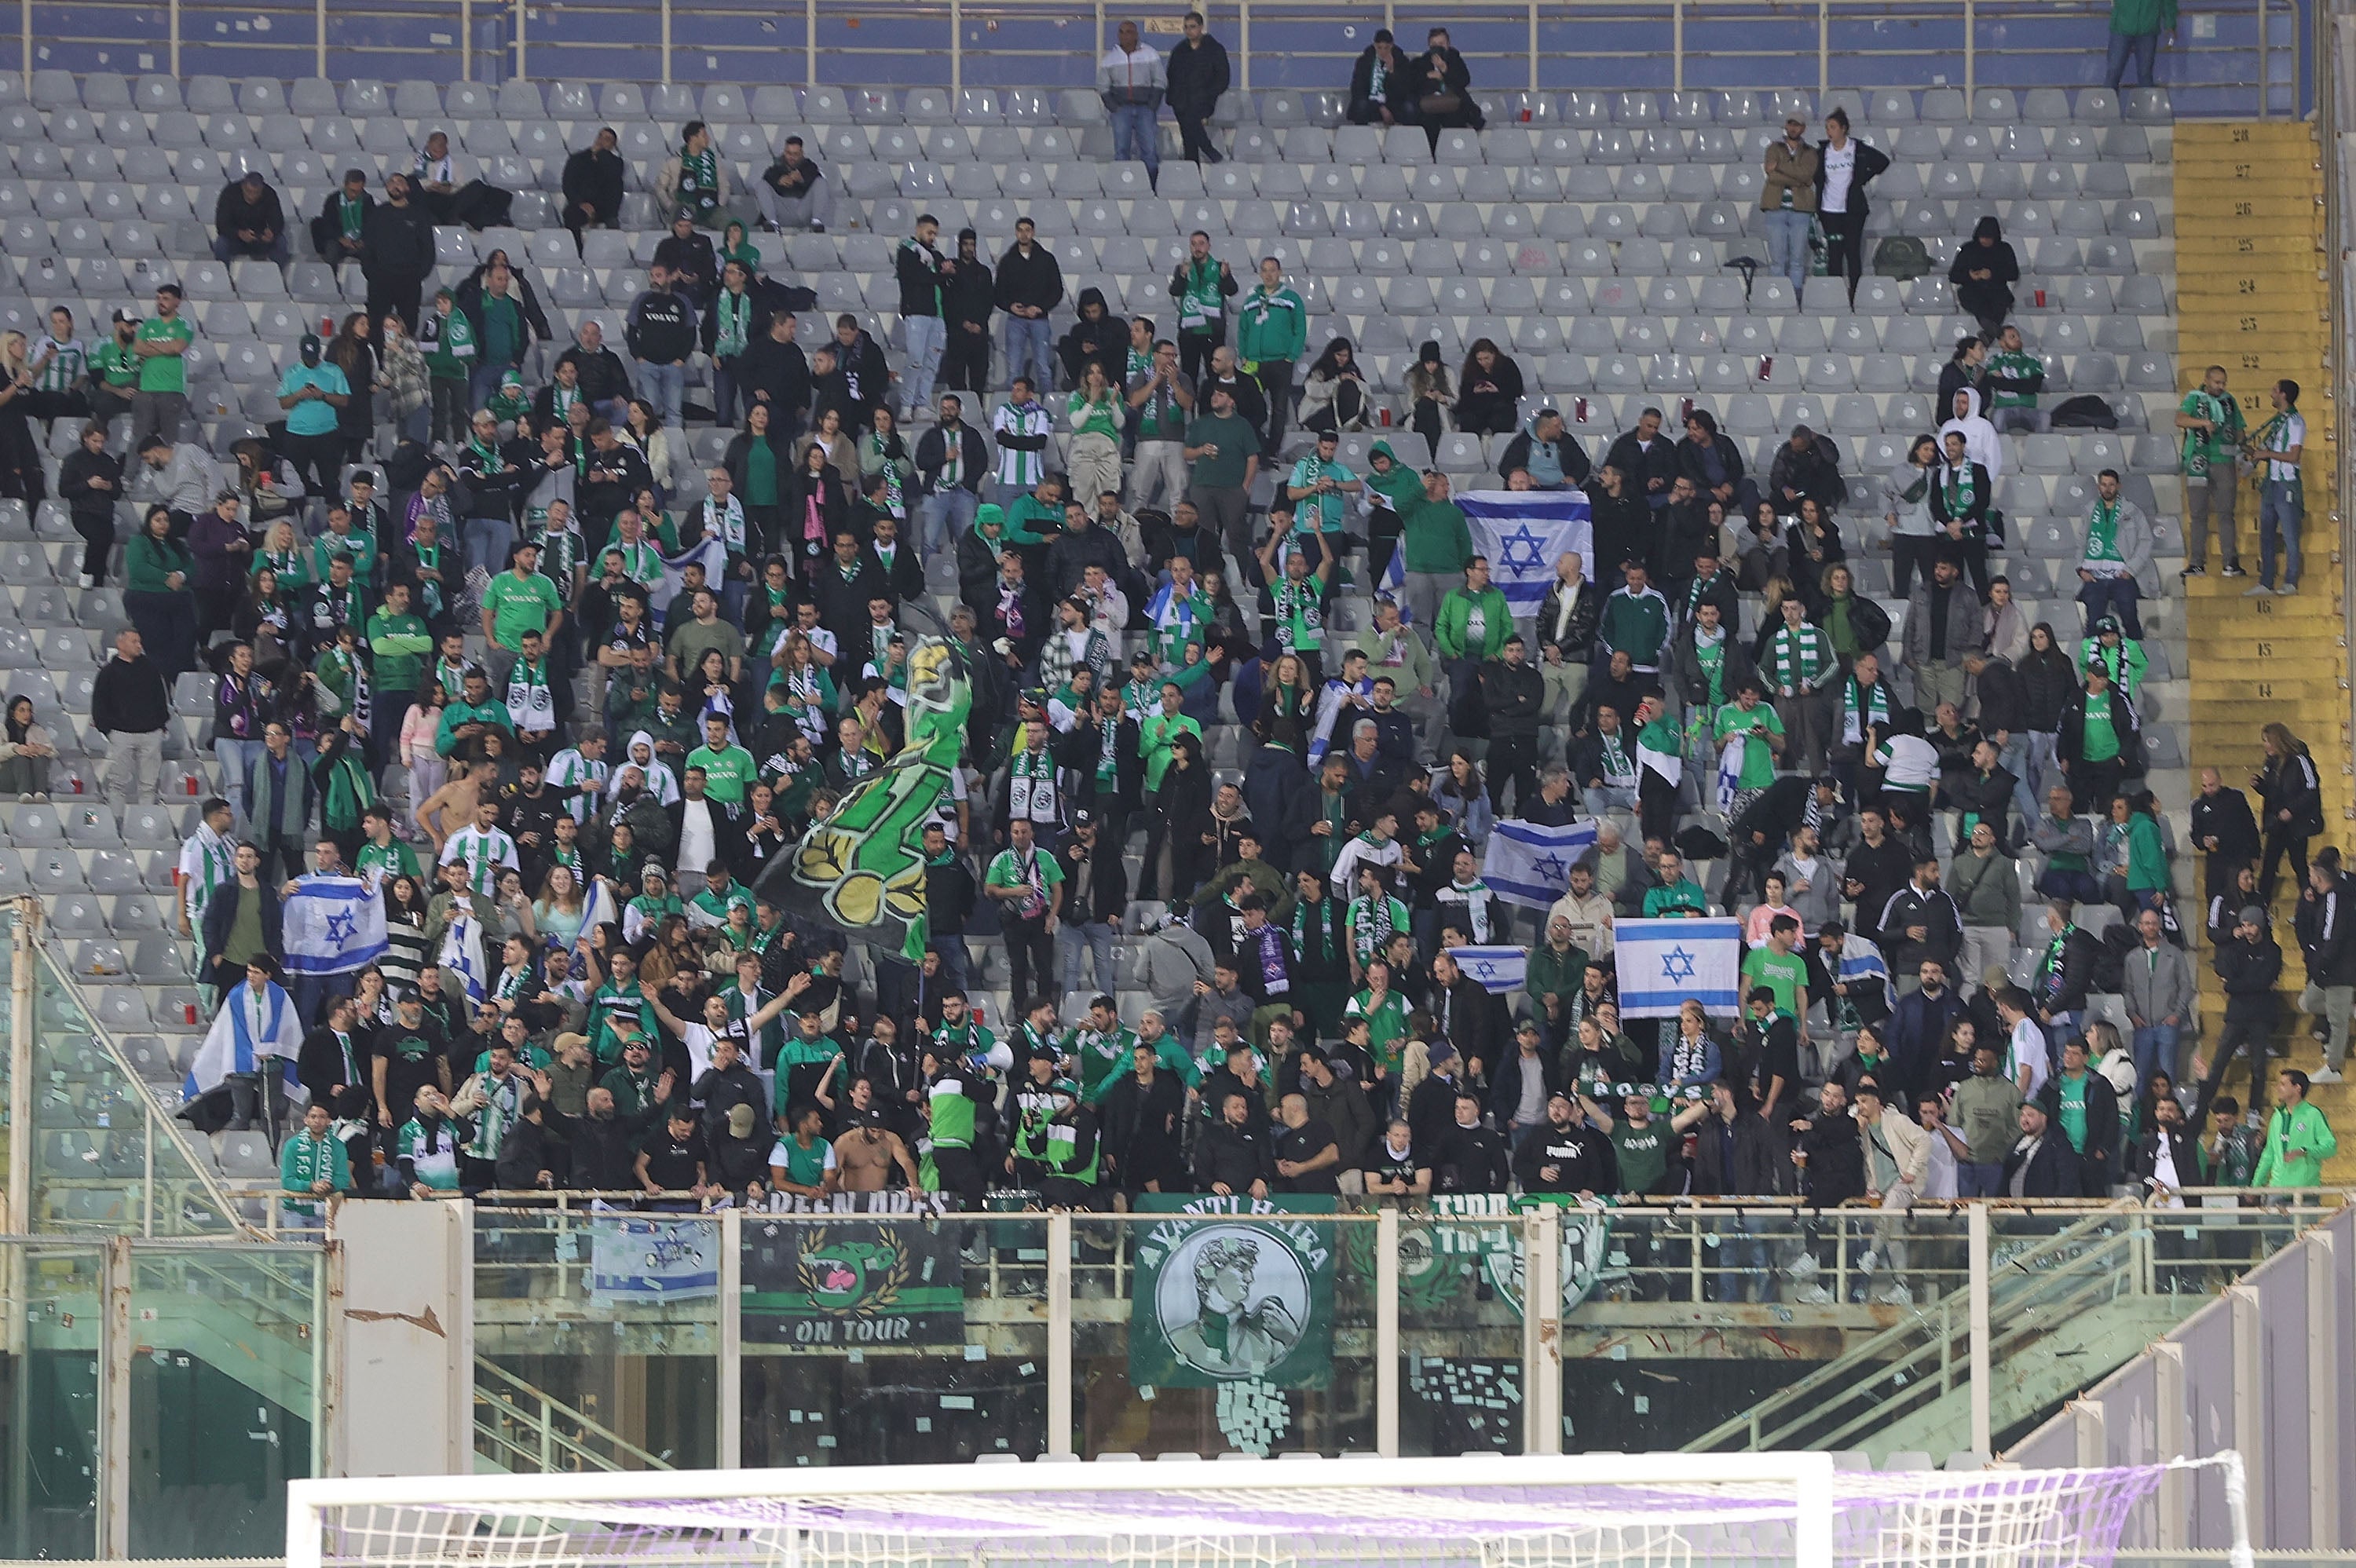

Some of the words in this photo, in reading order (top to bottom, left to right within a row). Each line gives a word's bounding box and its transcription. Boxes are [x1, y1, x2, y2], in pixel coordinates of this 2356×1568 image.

[646, 313, 679, 323] VOLVO
[503, 594, 541, 603] VOLVO
[2258, 643, 2272, 656] 15
[1546, 1145, 1577, 1159] PUMA
[1139, 1194, 1242, 1270] AVANTI
[796, 1320, 833, 1343] ON
[842, 1316, 911, 1342] TOUR
